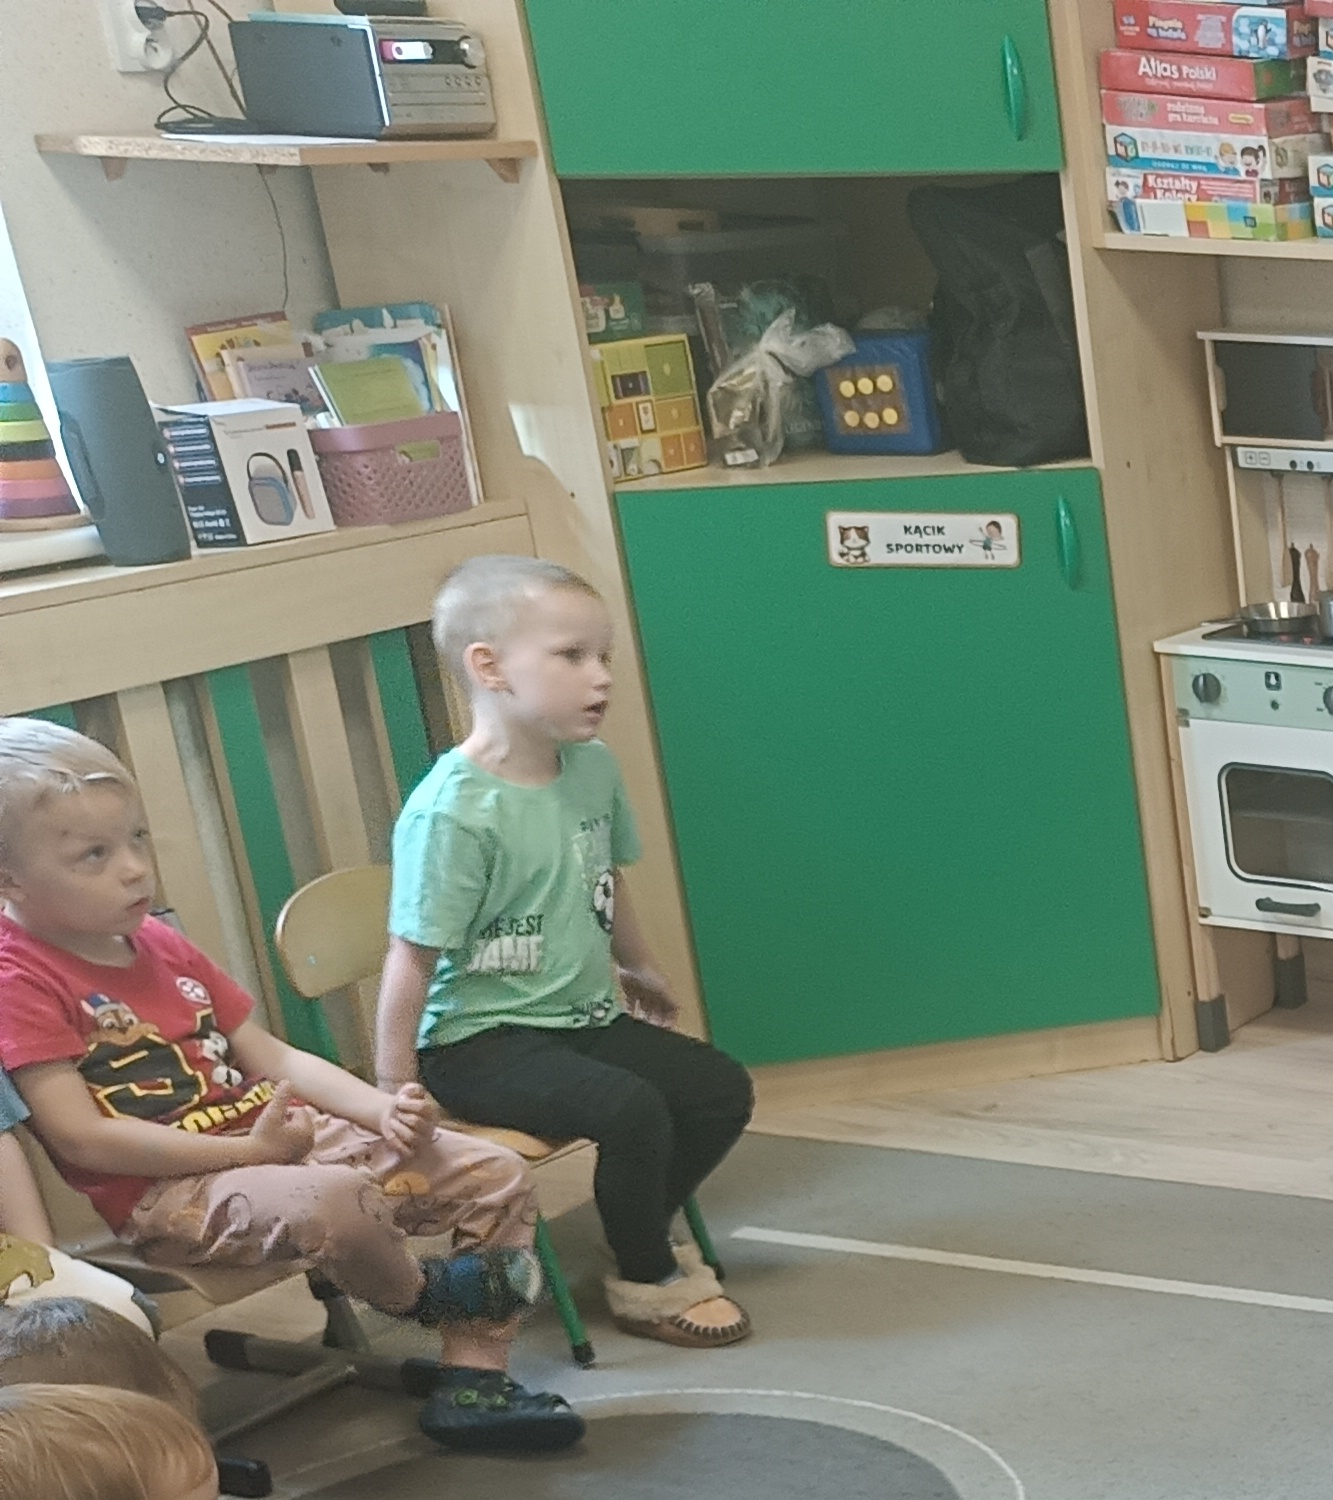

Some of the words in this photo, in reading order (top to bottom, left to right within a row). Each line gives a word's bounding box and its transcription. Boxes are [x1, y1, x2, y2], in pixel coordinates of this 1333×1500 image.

[1138, 57, 1179, 79] Atlas
[1182, 65, 1216, 81] Polski
[904, 525, 945, 538] KĄCIK
[886, 543, 964, 554] SPORTOWY
